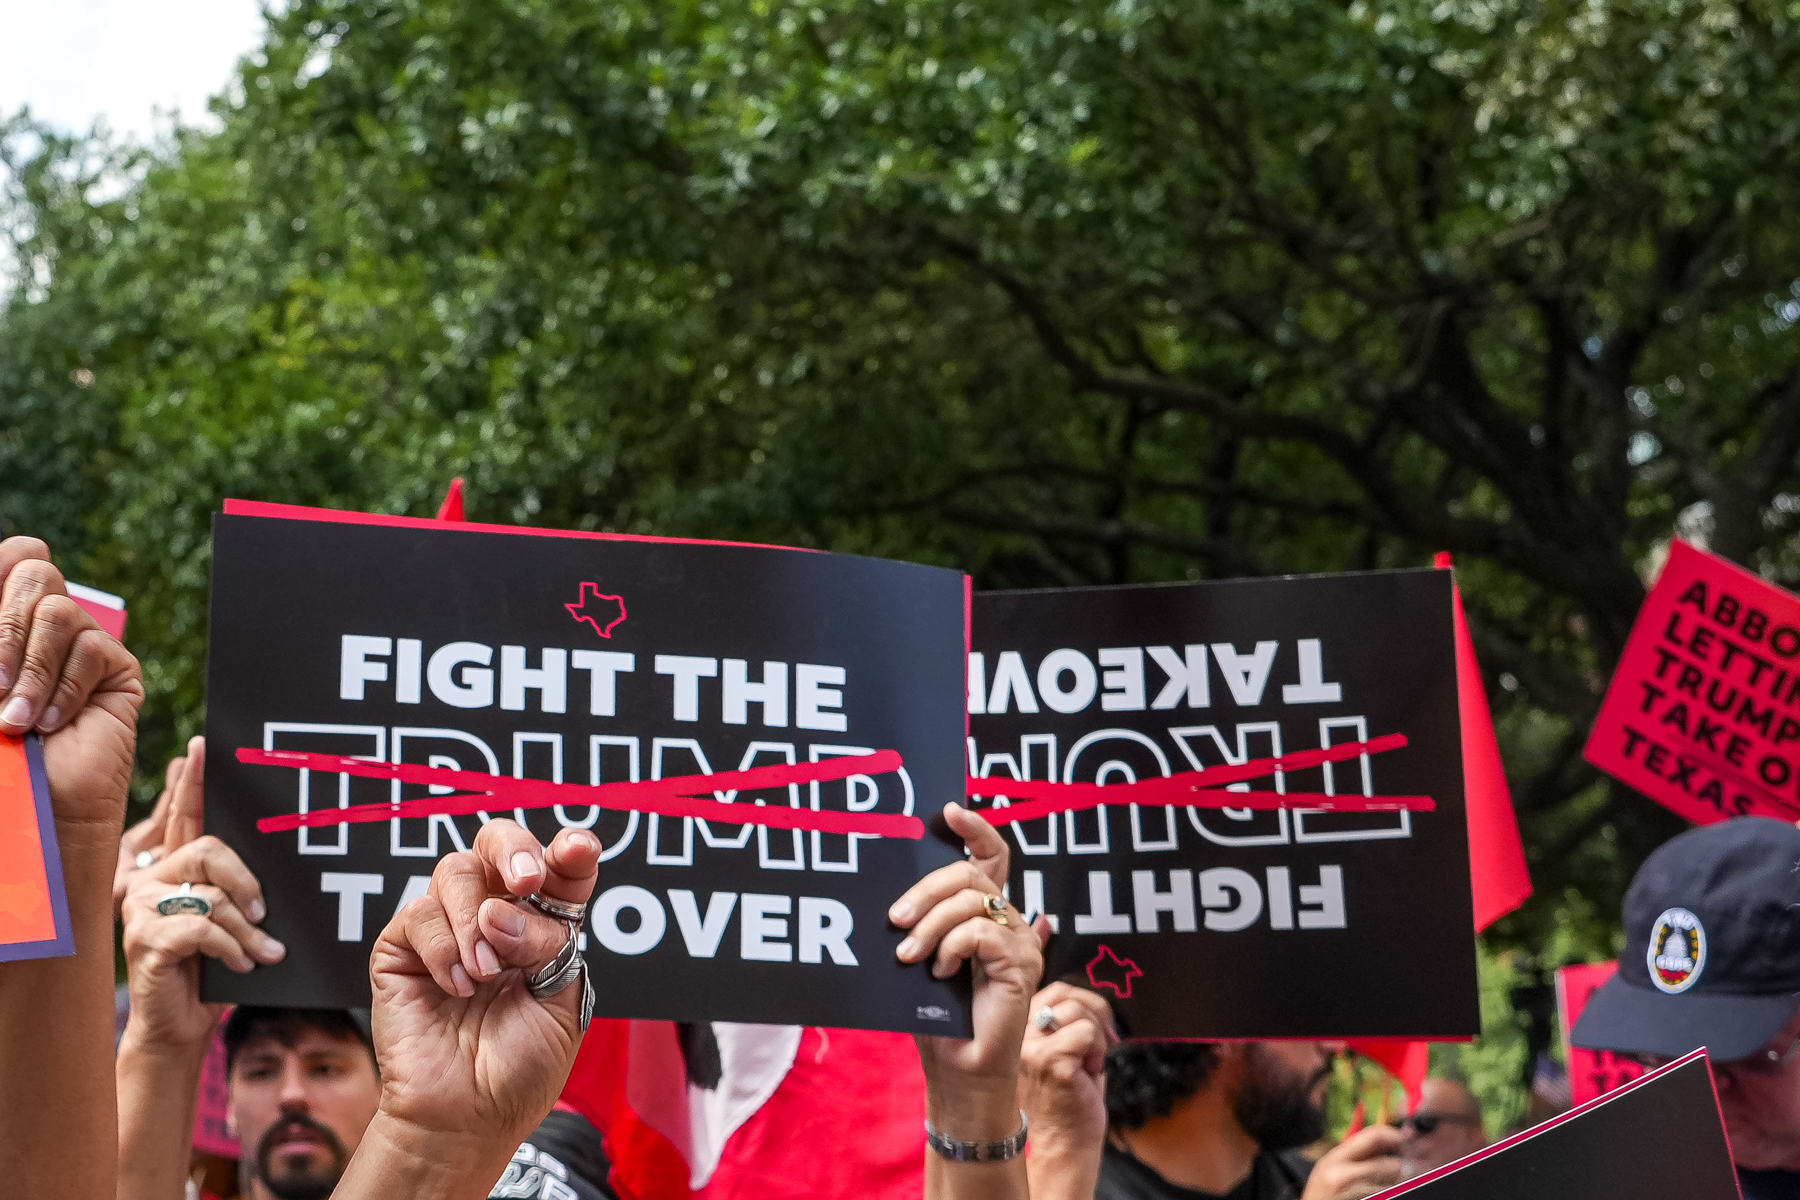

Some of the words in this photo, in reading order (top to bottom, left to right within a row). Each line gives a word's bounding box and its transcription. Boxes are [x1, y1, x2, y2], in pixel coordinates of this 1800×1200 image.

[339, 634, 635, 716] FIGHT
[654, 654, 848, 733] THE
[1640, 680, 1752, 768] TAKE
[1655, 645, 1800, 745] TRUMP
[264, 722, 914, 873] TRUMP
[1074, 864, 1347, 934] FIGHT
